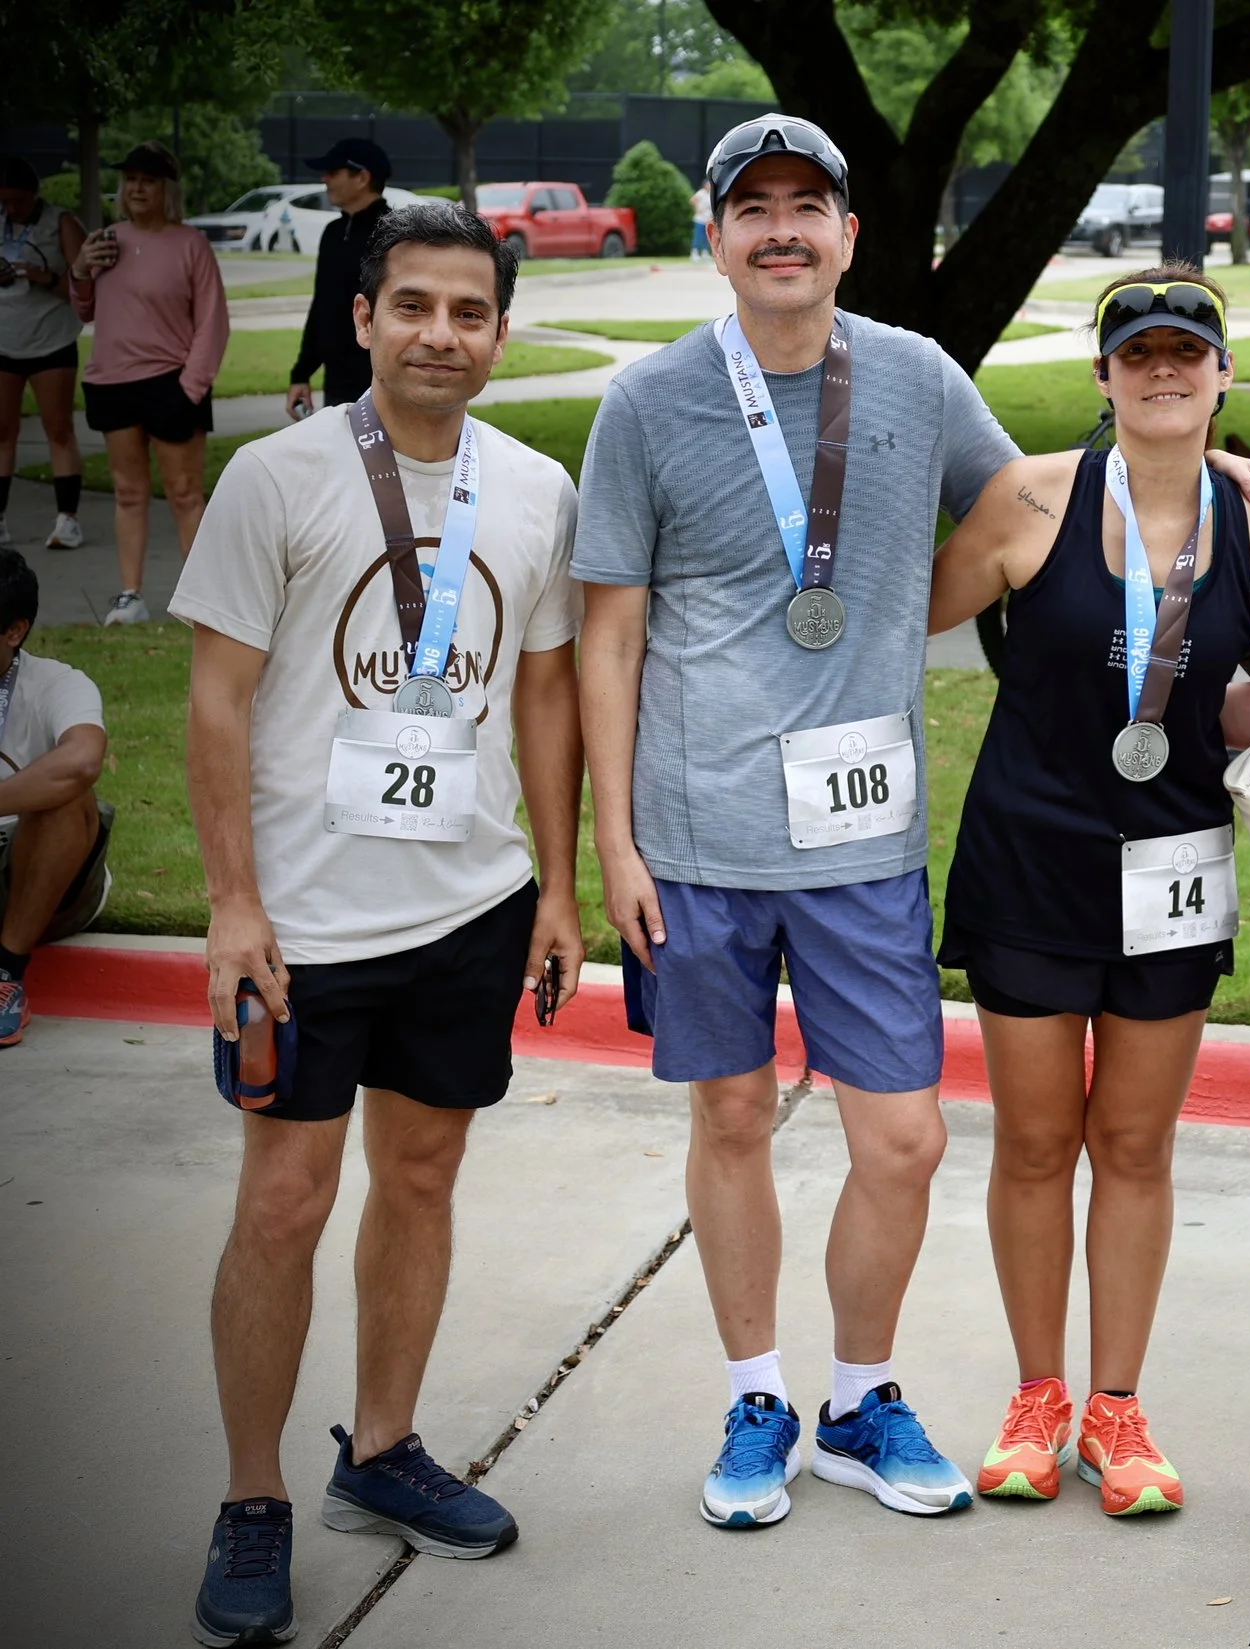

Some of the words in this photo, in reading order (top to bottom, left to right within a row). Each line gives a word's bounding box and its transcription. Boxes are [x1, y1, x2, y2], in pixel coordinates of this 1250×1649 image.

[731, 351, 759, 408] MUSTANG
[459, 427, 473, 486] MUSTANG
[793, 618, 841, 636] MUSTANG
[1119, 750, 1162, 768] MUSTANG
[381, 762, 437, 808] 28
[825, 763, 890, 813] 108
[340, 810, 379, 823] Results
[806, 822, 842, 834] Results
[1167, 876, 1206, 919] 14
